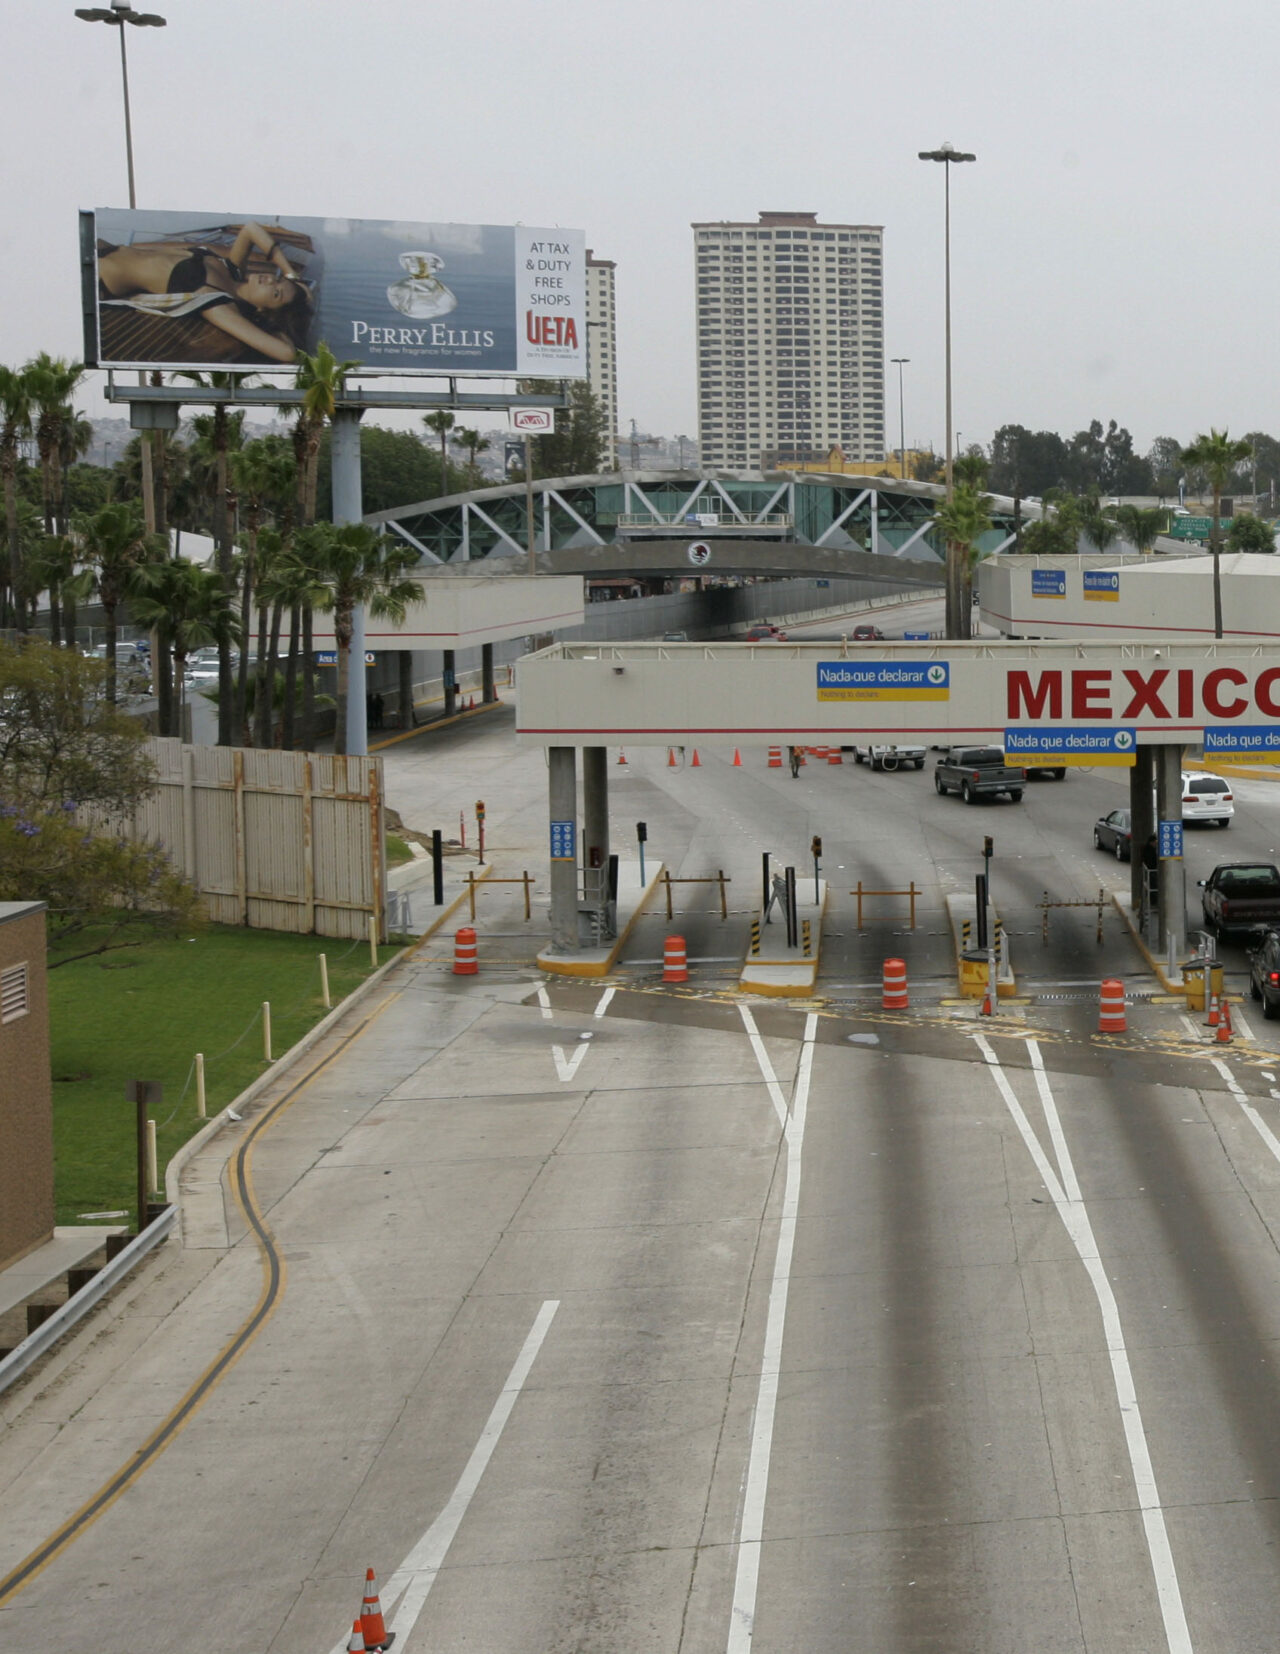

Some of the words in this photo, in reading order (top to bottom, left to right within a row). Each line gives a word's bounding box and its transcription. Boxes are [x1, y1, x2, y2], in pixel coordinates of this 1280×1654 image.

[530, 243, 544, 254] AT
[547, 243, 569, 255] TAX
[526, 259, 534, 270] &
[538, 260, 571, 271] DUTY
[535, 277, 563, 288] FREE
[530, 294, 571, 306] SHOPS
[351, 320, 427, 345] PERRY
[430, 323, 494, 347] ELLIS
[526, 309, 578, 350] UETA
[820, 669, 851, 682] Nada
[878, 669, 924, 682] declarar
[1007, 734, 1038, 747] Nada
[1041, 737, 1063, 750] que
[1065, 734, 1112, 747] declarar
[1207, 733, 1238, 746] Nada
[1240, 736, 1262, 748] que
